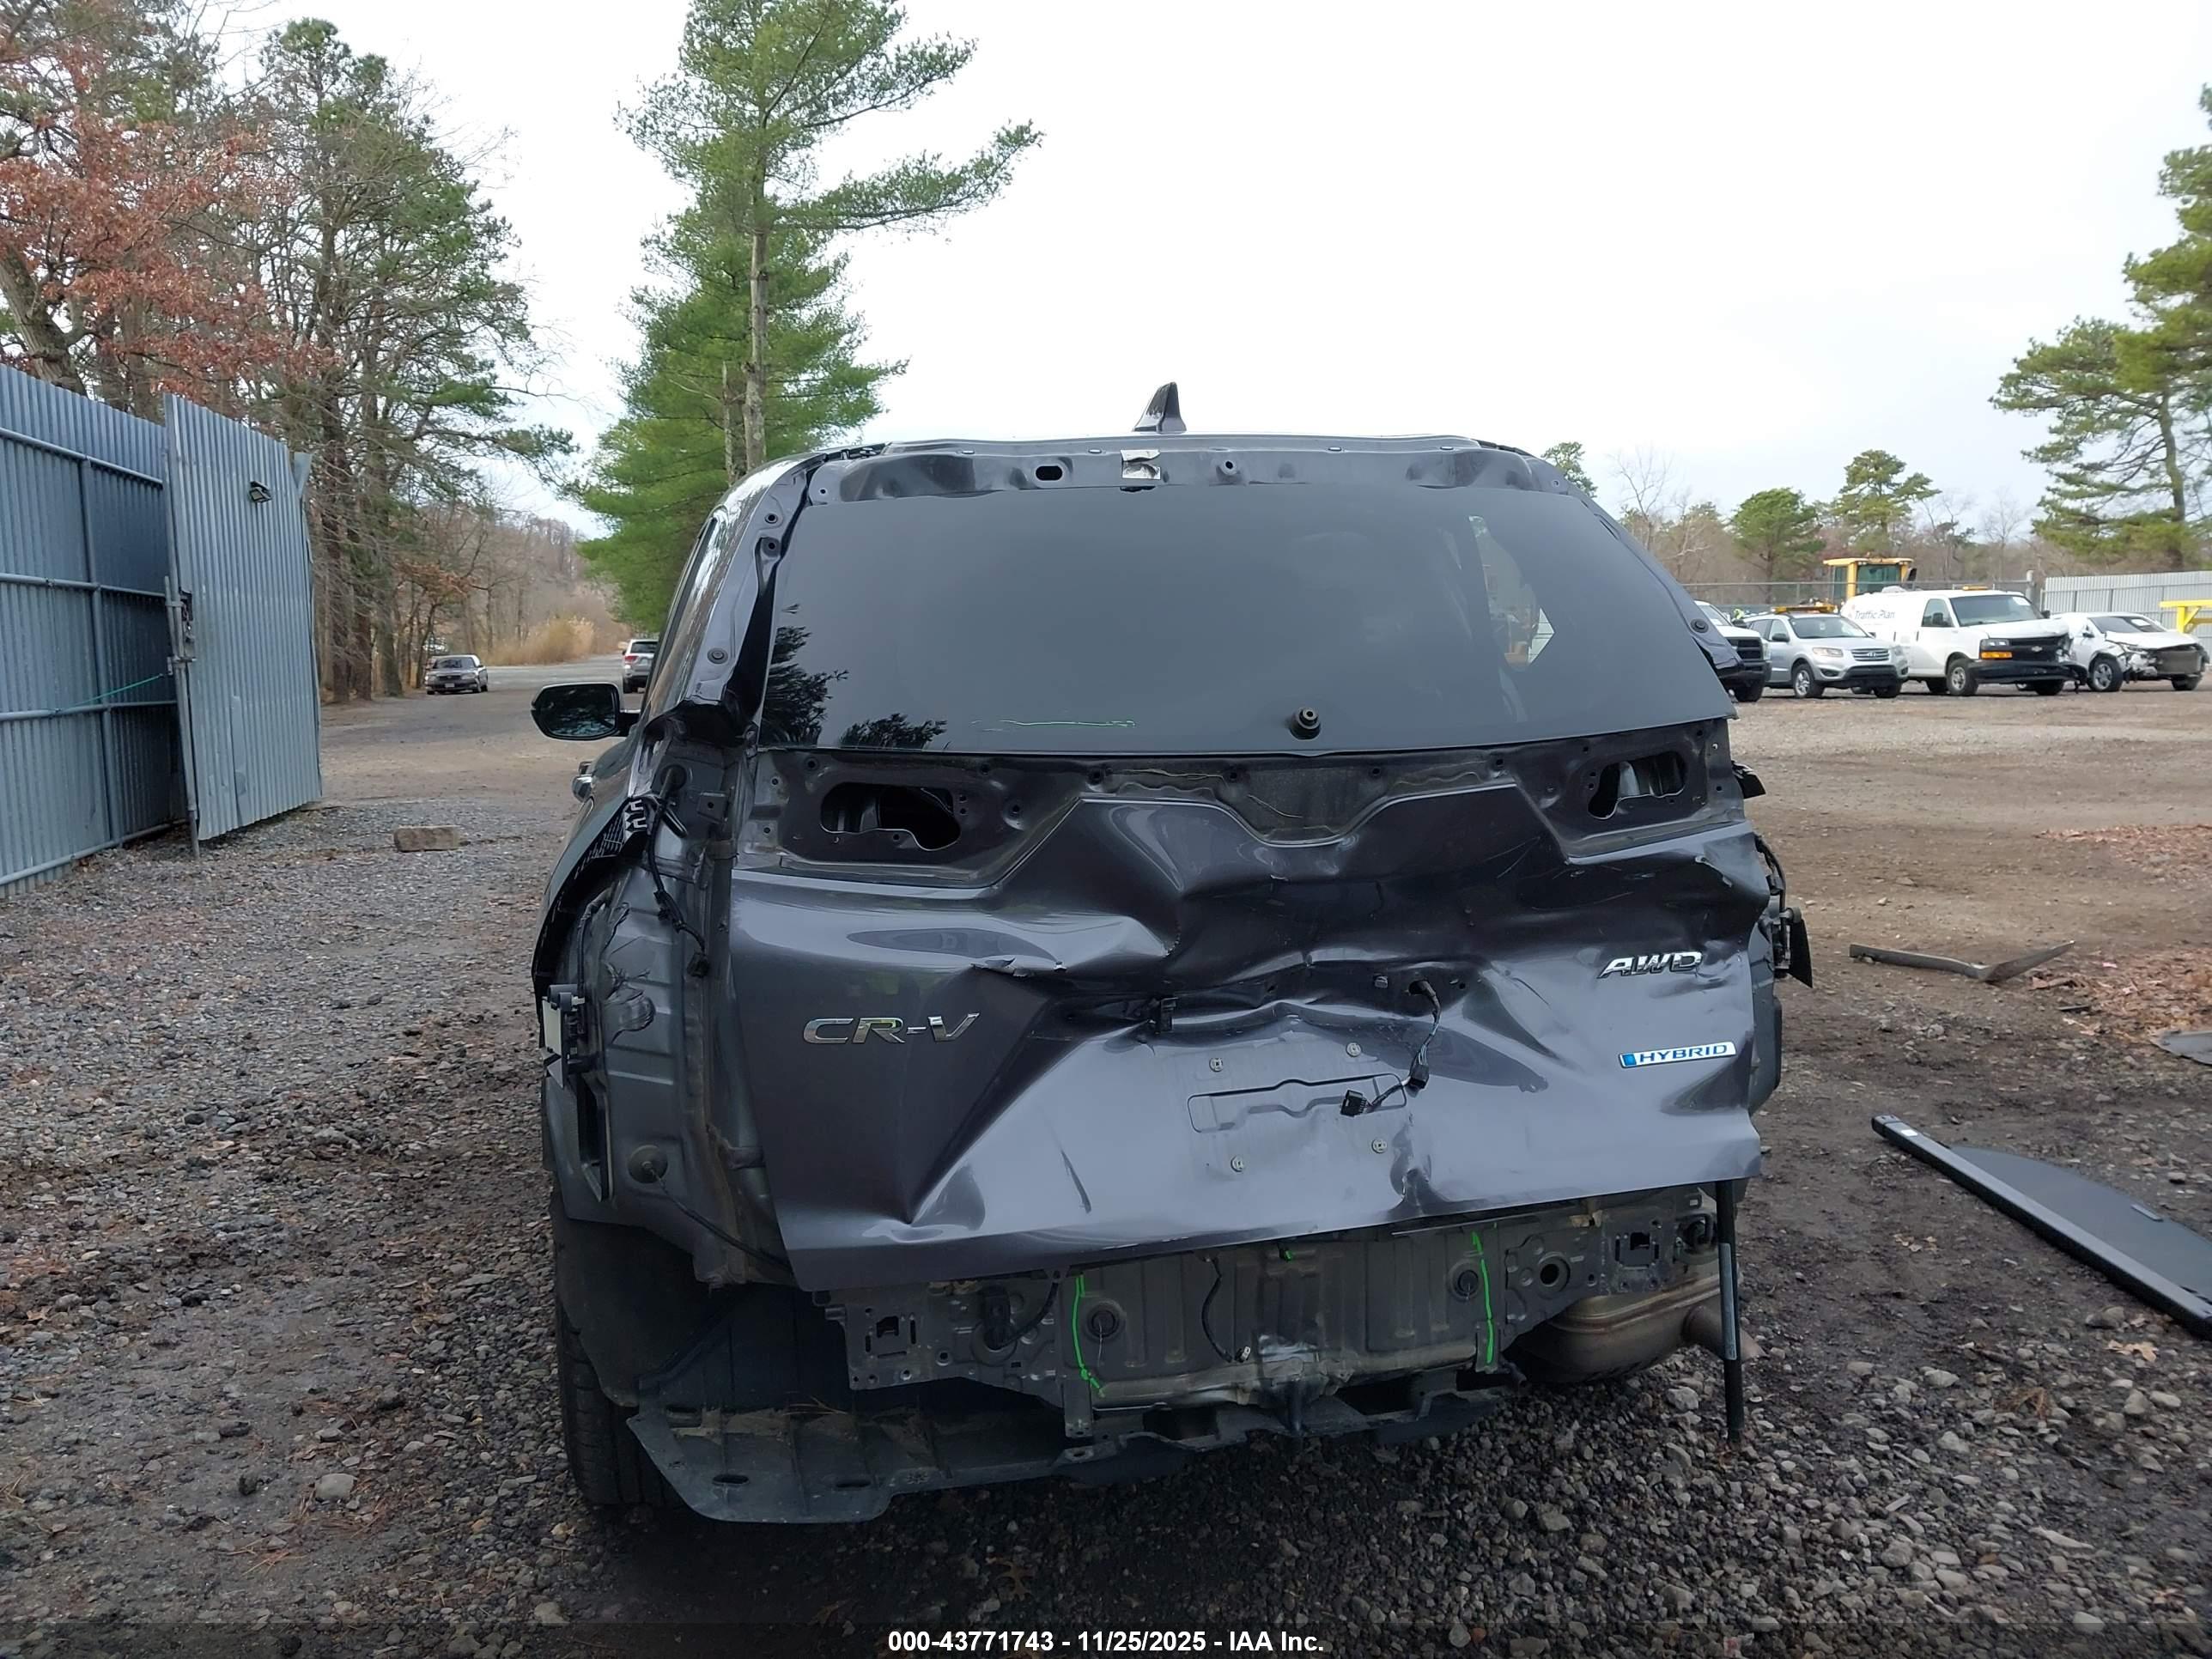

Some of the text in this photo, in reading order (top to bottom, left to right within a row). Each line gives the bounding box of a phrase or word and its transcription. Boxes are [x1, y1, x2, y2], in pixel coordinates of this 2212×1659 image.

[1855, 610, 1895, 619] Traffic Plan
[1597, 951, 1703, 979] AWD
[803, 1012, 980, 1044] CR-V
[1639, 1044, 1728, 1063] HYBRID
